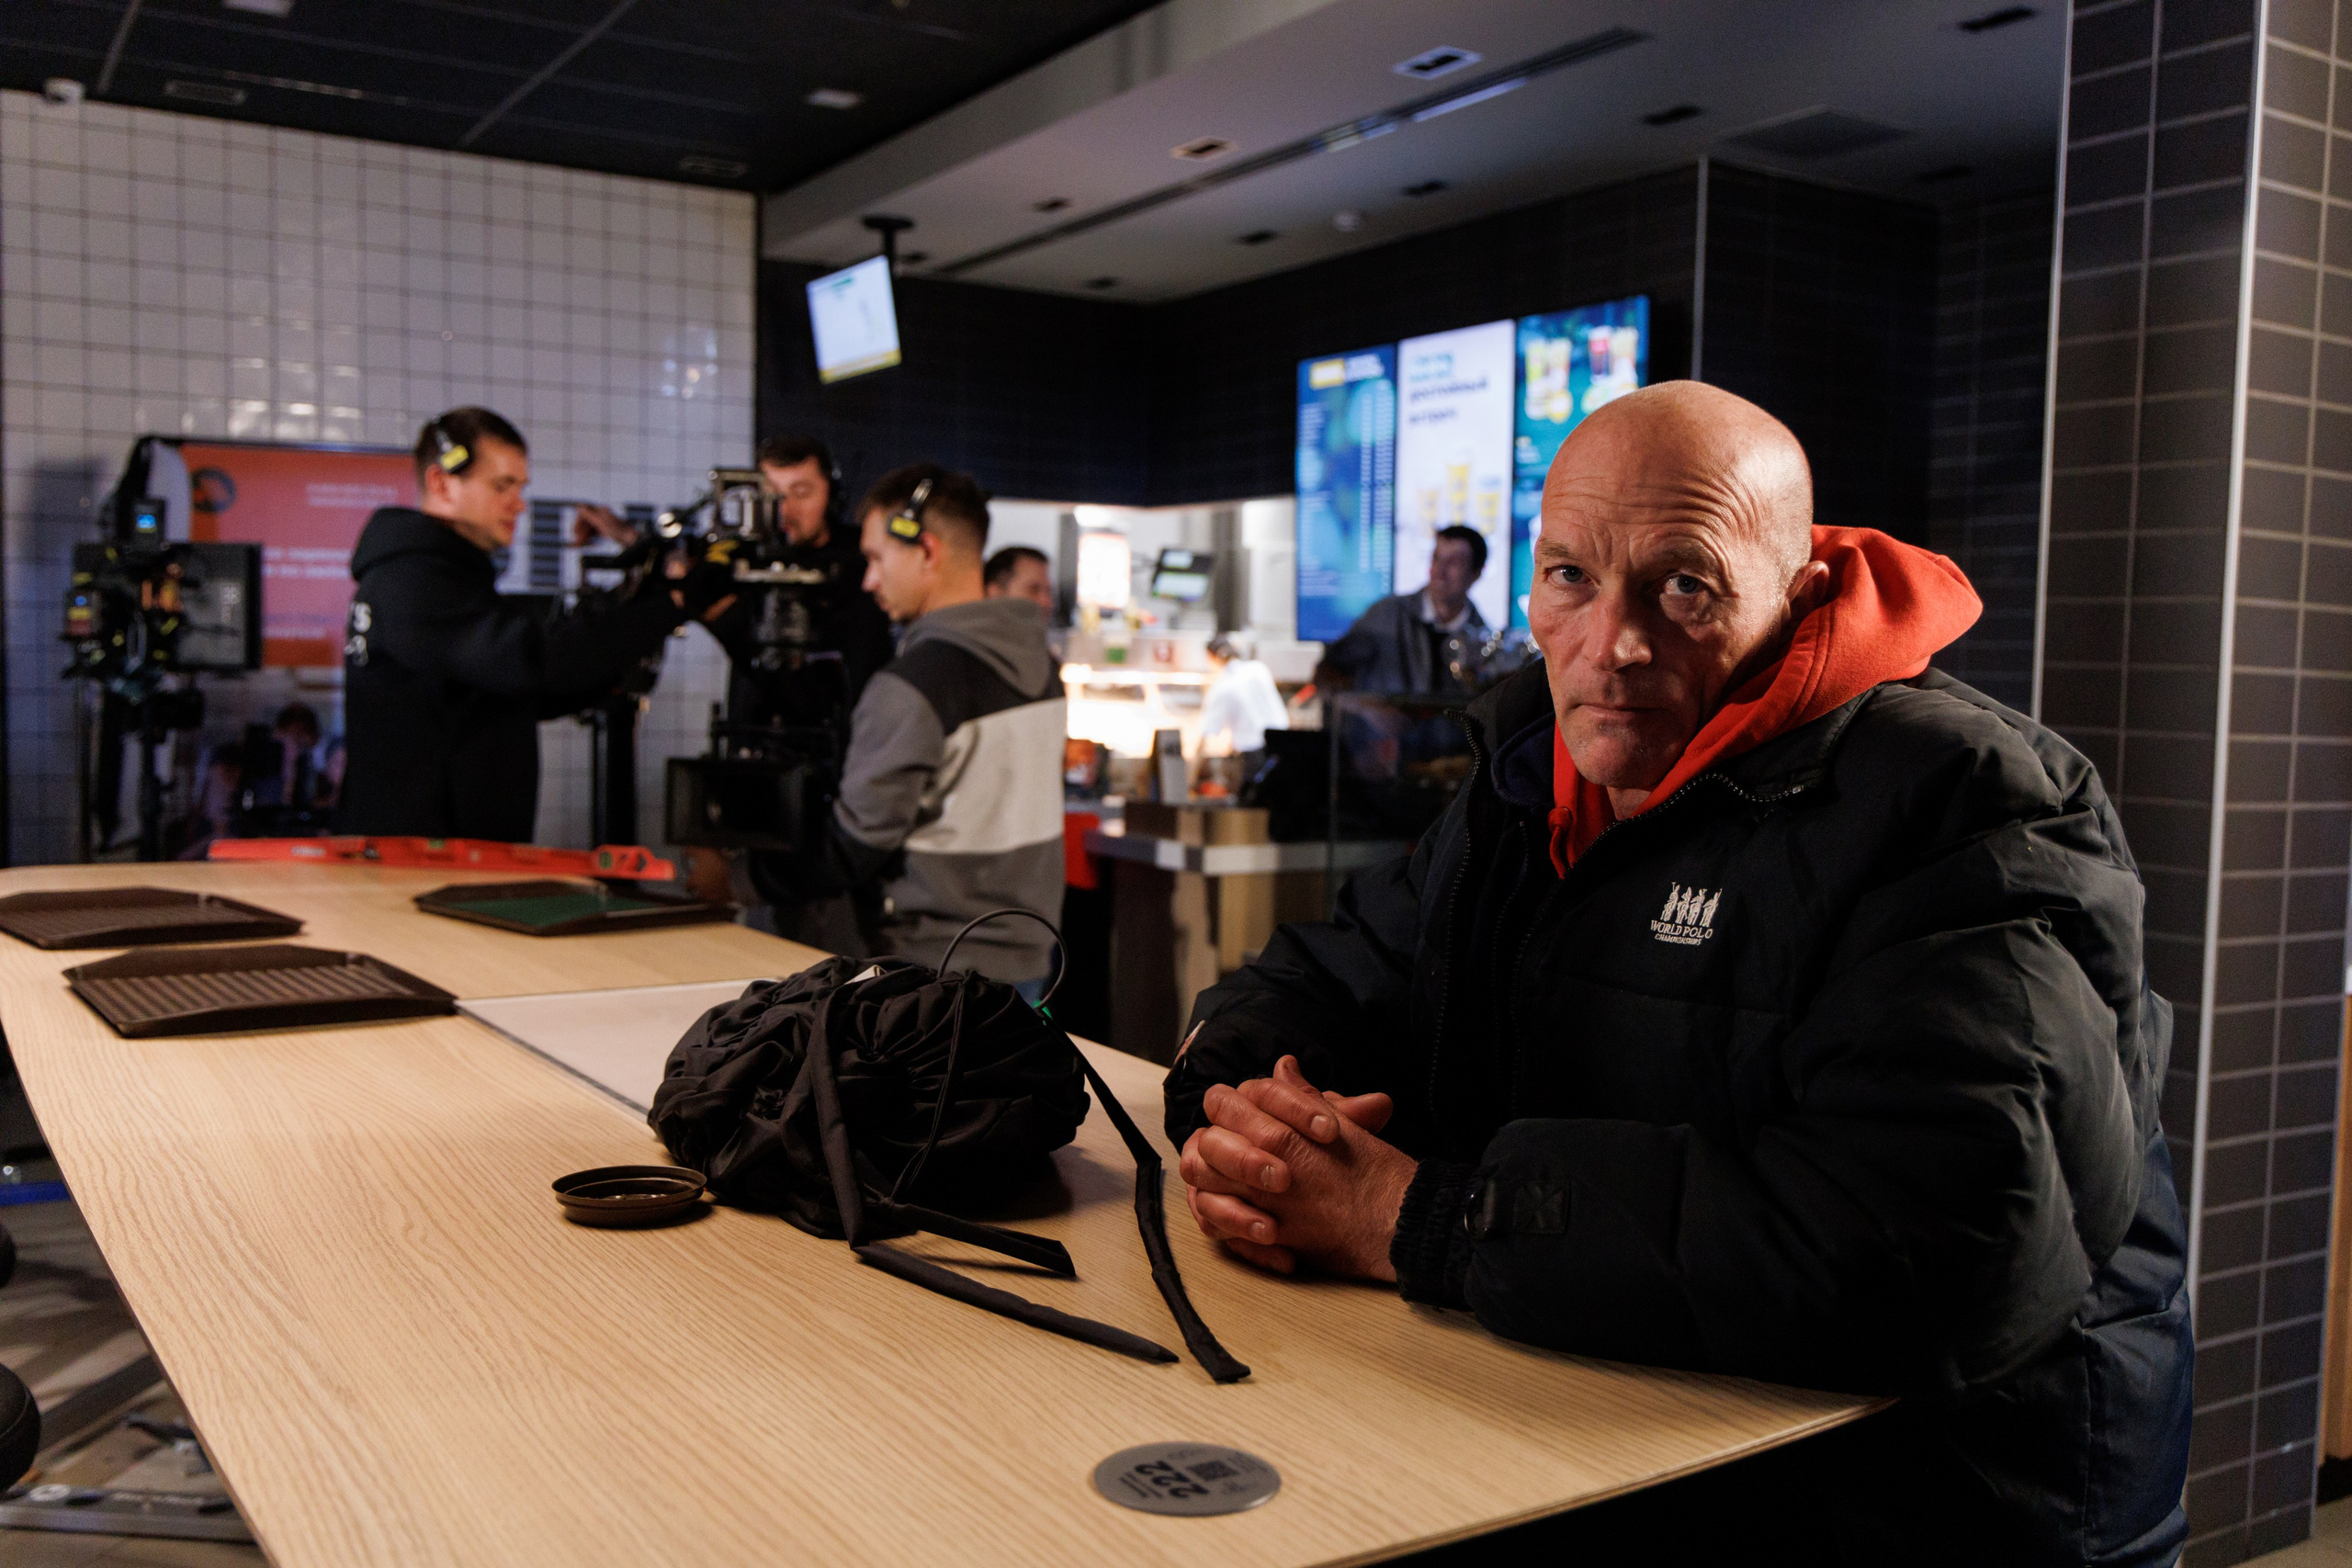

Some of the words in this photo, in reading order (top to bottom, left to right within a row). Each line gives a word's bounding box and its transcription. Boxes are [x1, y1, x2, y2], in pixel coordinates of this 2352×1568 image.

[1650, 920, 1682, 935] WORLD
[1682, 926, 1713, 939] POLO
[1655, 933, 1702, 945] CHAMPIONSHIPS
[1134, 1460, 1210, 1499] 222
